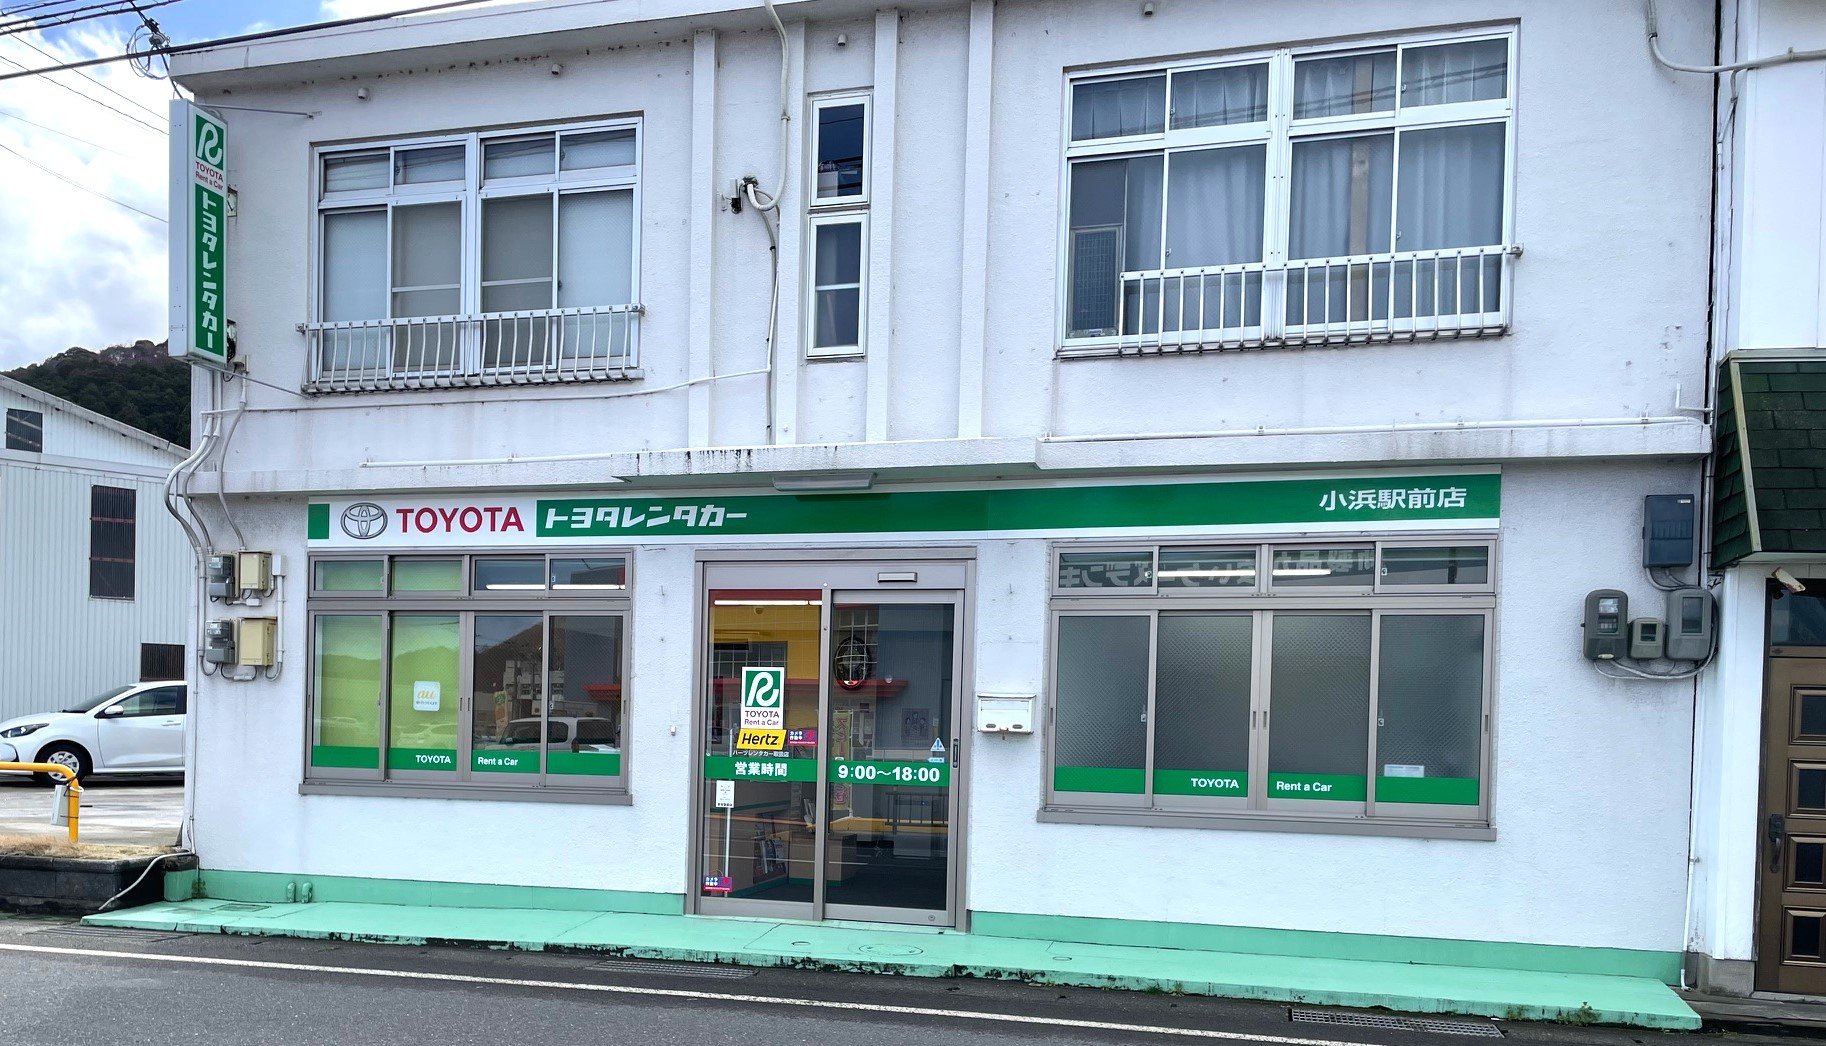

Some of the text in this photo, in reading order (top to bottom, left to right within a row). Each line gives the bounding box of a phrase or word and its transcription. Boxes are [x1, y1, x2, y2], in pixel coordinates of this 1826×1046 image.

[195, 161, 224, 182] TOYOTA
[195, 170, 209, 184] Rent
[213, 180, 224, 191] Car
[202, 191, 218, 349] トヨタレンタカー
[1319, 487, 1467, 511] 小浜駅前店
[396, 506, 525, 534] TOYOTA
[545, 504, 748, 529] トヨタレンタカー
[744, 710, 780, 719] TOYOTA
[744, 718, 760, 726] Rent
[766, 718, 779, 726] Car
[741, 732, 779, 746] Hertz
[415, 754, 519, 766] TOYOTA Rent a Car
[735, 761, 788, 777] 営業時間
[1190, 777, 1333, 792] TOYOTA Rent a Car
